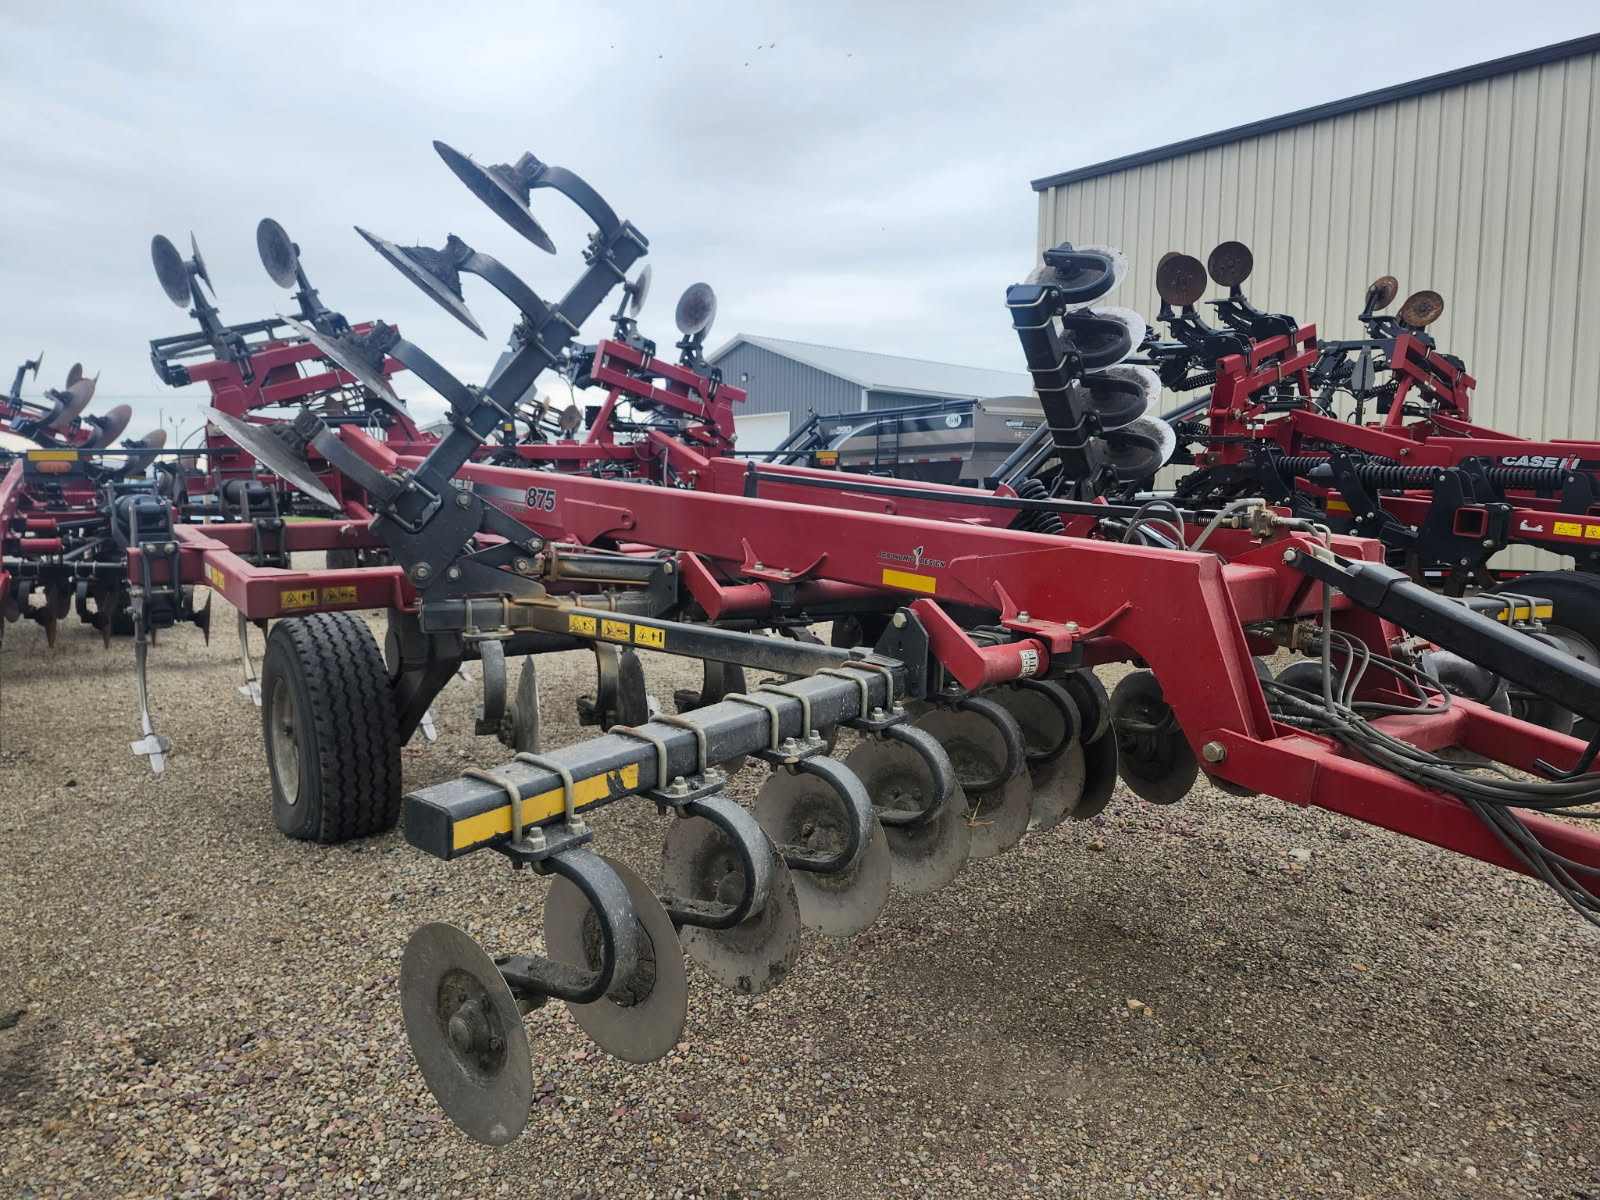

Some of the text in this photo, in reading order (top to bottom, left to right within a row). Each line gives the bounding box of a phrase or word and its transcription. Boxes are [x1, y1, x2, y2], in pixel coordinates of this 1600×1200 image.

[1502, 455, 1559, 469] CASE
[526, 487, 556, 512] 875
[920, 558, 945, 568] DESIGN
